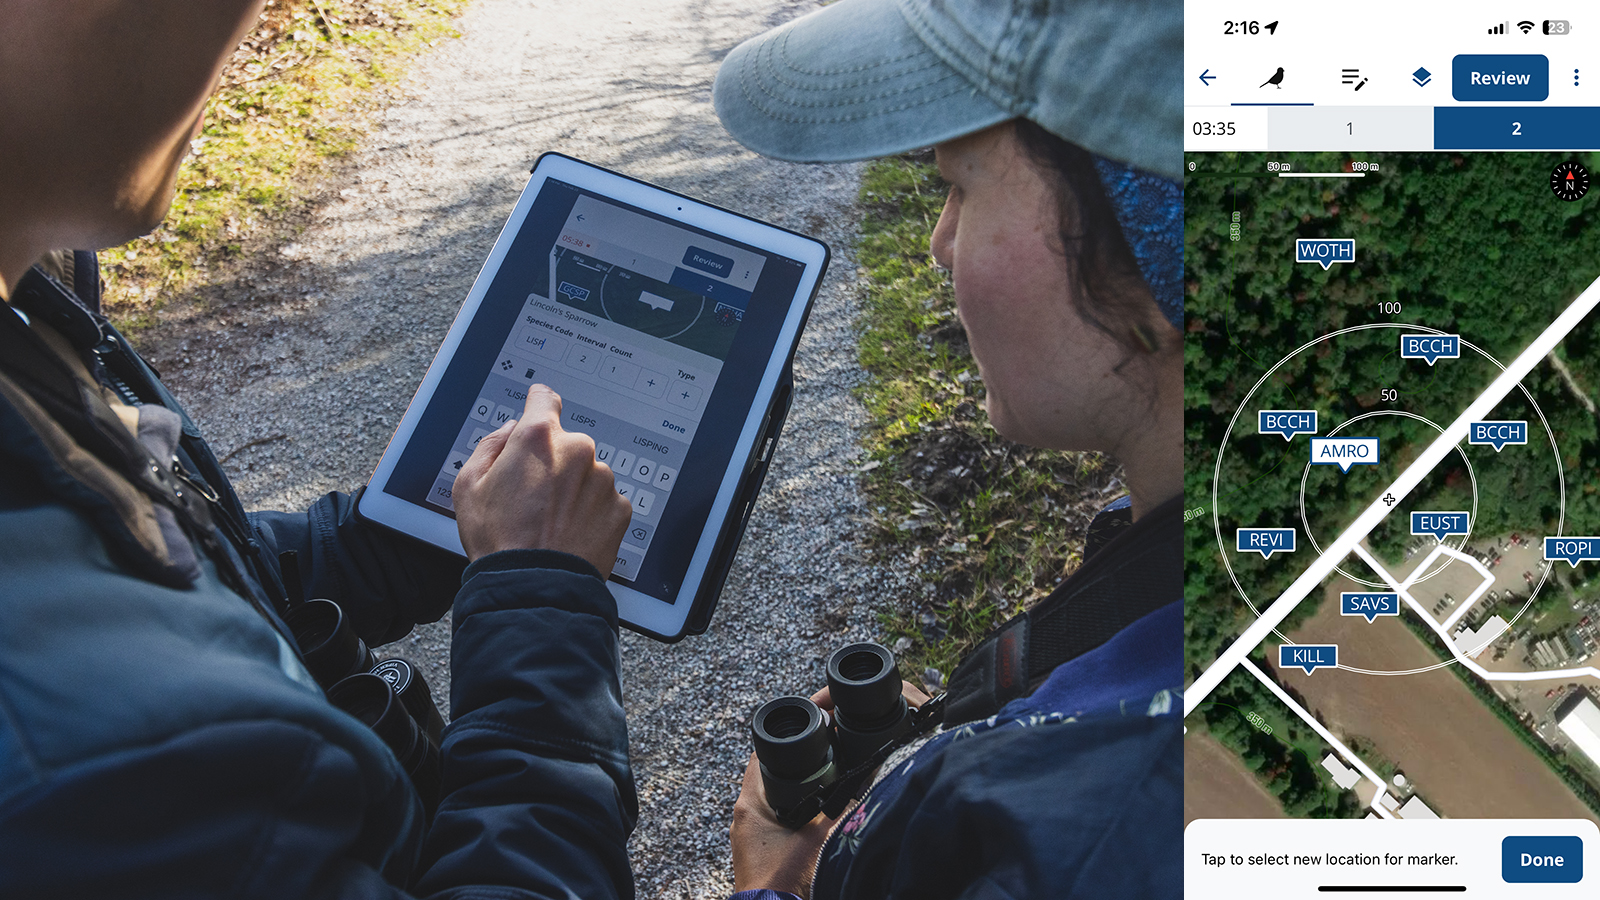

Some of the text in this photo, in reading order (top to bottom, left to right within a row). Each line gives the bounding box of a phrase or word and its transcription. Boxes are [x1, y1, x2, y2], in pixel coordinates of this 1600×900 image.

[1224, 21, 1260, 35] 2:16
[1547, 22, 1565, 33] 23
[1470, 70, 1531, 86] Review
[1192, 121, 1236, 136] 03:35
[1346, 121, 1354, 136] 1
[1511, 121, 1522, 136] 2
[1188, 161, 1197, 172] 0
[1267, 161, 1290, 172] 50 m
[1351, 161, 1379, 172] 100 m
[1565, 180, 1575, 191] N
[1230, 222, 1241, 241] 350
[562, 234, 584, 248] 05:38
[1300, 243, 1350, 258] WOTH
[693, 253, 724, 271] Review
[563, 284, 586, 298] GCSP
[706, 284, 714, 294] 2
[529, 298, 598, 329] Lincoln's Sparrow
[1378, 301, 1402, 314] 100
[526, 315, 696, 382] Species Code Interval Count Type
[1409, 339, 1452, 353] BCCH
[579, 355, 587, 364] 2
[1381, 388, 1398, 401] 50
[571, 412, 597, 428] LISPS
[661, 419, 686, 434] Done
[1266, 414, 1310, 429] BCCH
[1476, 425, 1520, 440] BCCH
[477, 404, 670, 483] Q W U I O P
[633, 435, 670, 455] LISPING
[1319, 443, 1370, 459] AMRO
[638, 496, 646, 508] L
[1193, 507, 1205, 517] m
[1421, 516, 1461, 530] EUST
[1250, 532, 1283, 547] REVI
[1555, 541, 1592, 556] ROPI
[1350, 596, 1390, 611] SAVS
[1293, 649, 1325, 663] KILL
[1246, 711, 1273, 735] 350 m
[1201, 852, 1458, 868] Tap to select new location for marker.
[1520, 853, 1565, 867] Done
